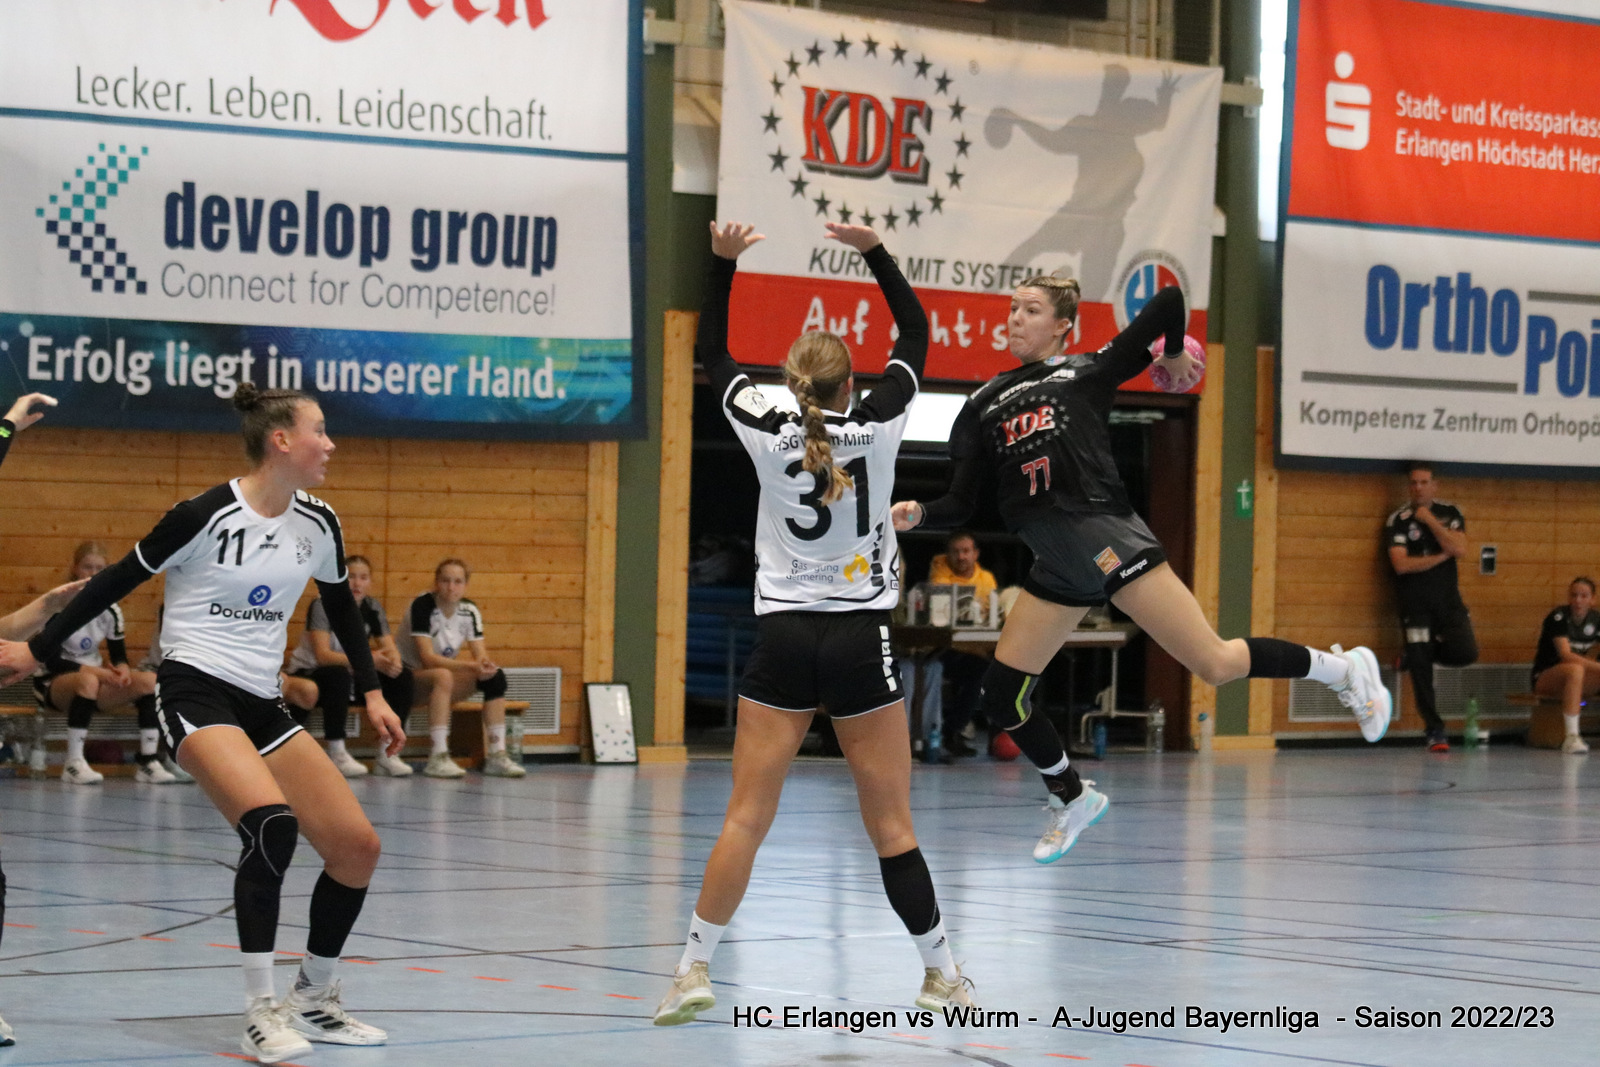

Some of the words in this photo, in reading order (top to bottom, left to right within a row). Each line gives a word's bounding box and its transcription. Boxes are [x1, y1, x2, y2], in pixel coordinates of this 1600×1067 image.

[75, 65, 192, 115] Lecker.
[208, 75, 321, 124] Leben.
[338, 87, 553, 141] Leidenschaft.
[1396, 89, 1448, 121] Stadt-
[1452, 99, 1486, 125] und
[1490, 102, 1600, 138] Kreissparkas
[801, 85, 931, 185] KDE
[1395, 127, 1473, 166] Erlangen
[1478, 137, 1566, 170] Höchstadt
[1569, 147, 1600, 174] Her
[163, 180, 391, 267] develop
[411, 206, 559, 277] group
[161, 261, 297, 304] Connect
[309, 270, 349, 306] for
[361, 273, 556, 319] Competence!
[808, 248, 898, 279] KURI
[906, 256, 946, 283] MIT
[802, 296, 869, 345] Auf
[1364, 264, 1521, 356] Ortho
[27, 336, 154, 396] Erfolg
[165, 340, 256, 396] liegt
[267, 345, 302, 391] in
[315, 357, 458, 396] unserer
[467, 356, 567, 400] Hand.
[1002, 405, 1055, 447] KDE
[1300, 400, 1426, 433] Kompetenz
[1431, 407, 1517, 433] Zentrum
[784, 456, 871, 541] 31
[1021, 456, 1050, 496] 77
[217, 528, 246, 566] 11
[1120, 558, 1148, 579] Kempa
[209, 602, 284, 622] DocuWare
